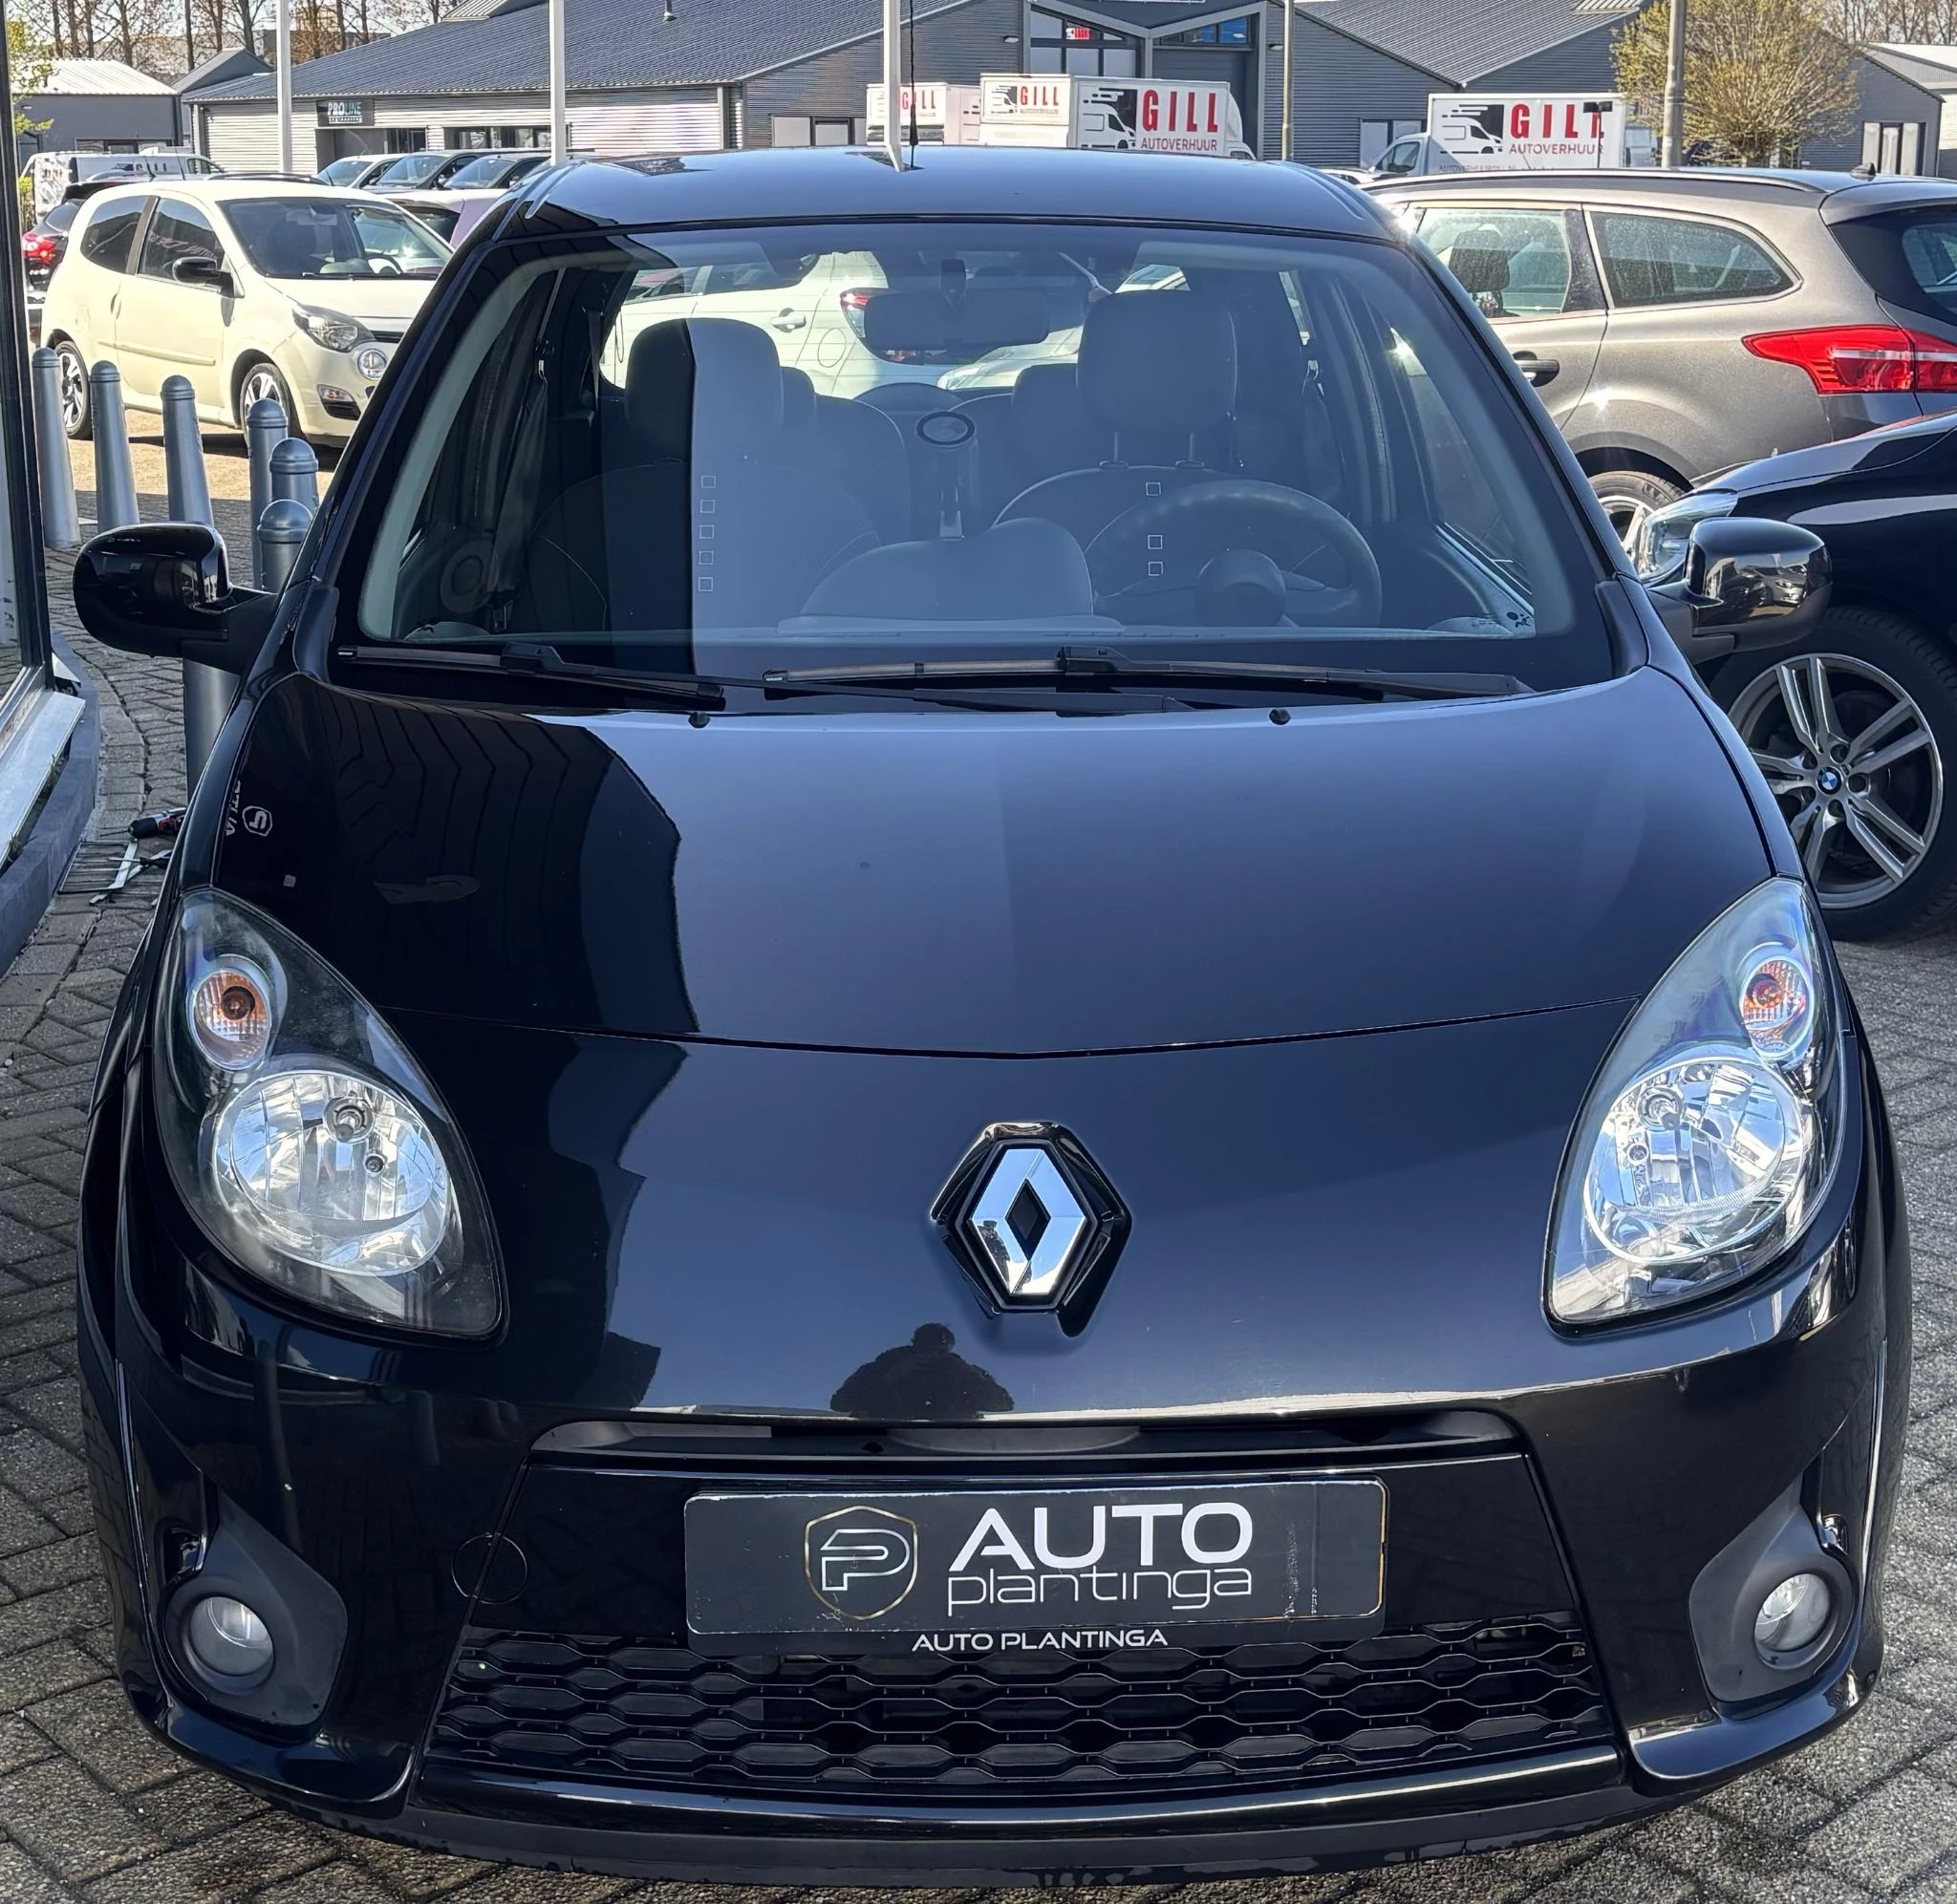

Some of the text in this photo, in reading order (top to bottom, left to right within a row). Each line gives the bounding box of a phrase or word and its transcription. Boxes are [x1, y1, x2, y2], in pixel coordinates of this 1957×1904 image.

[1021, 86, 1059, 106] GILL
[1142, 90, 1218, 133] GILL
[1141, 138, 1217, 152] AUTOVERHUUR
[949, 1502, 1253, 1572] AUTO
[948, 1565, 1252, 1616] plantinga
[912, 1628, 1168, 1652] AUTO PLANTINGA
